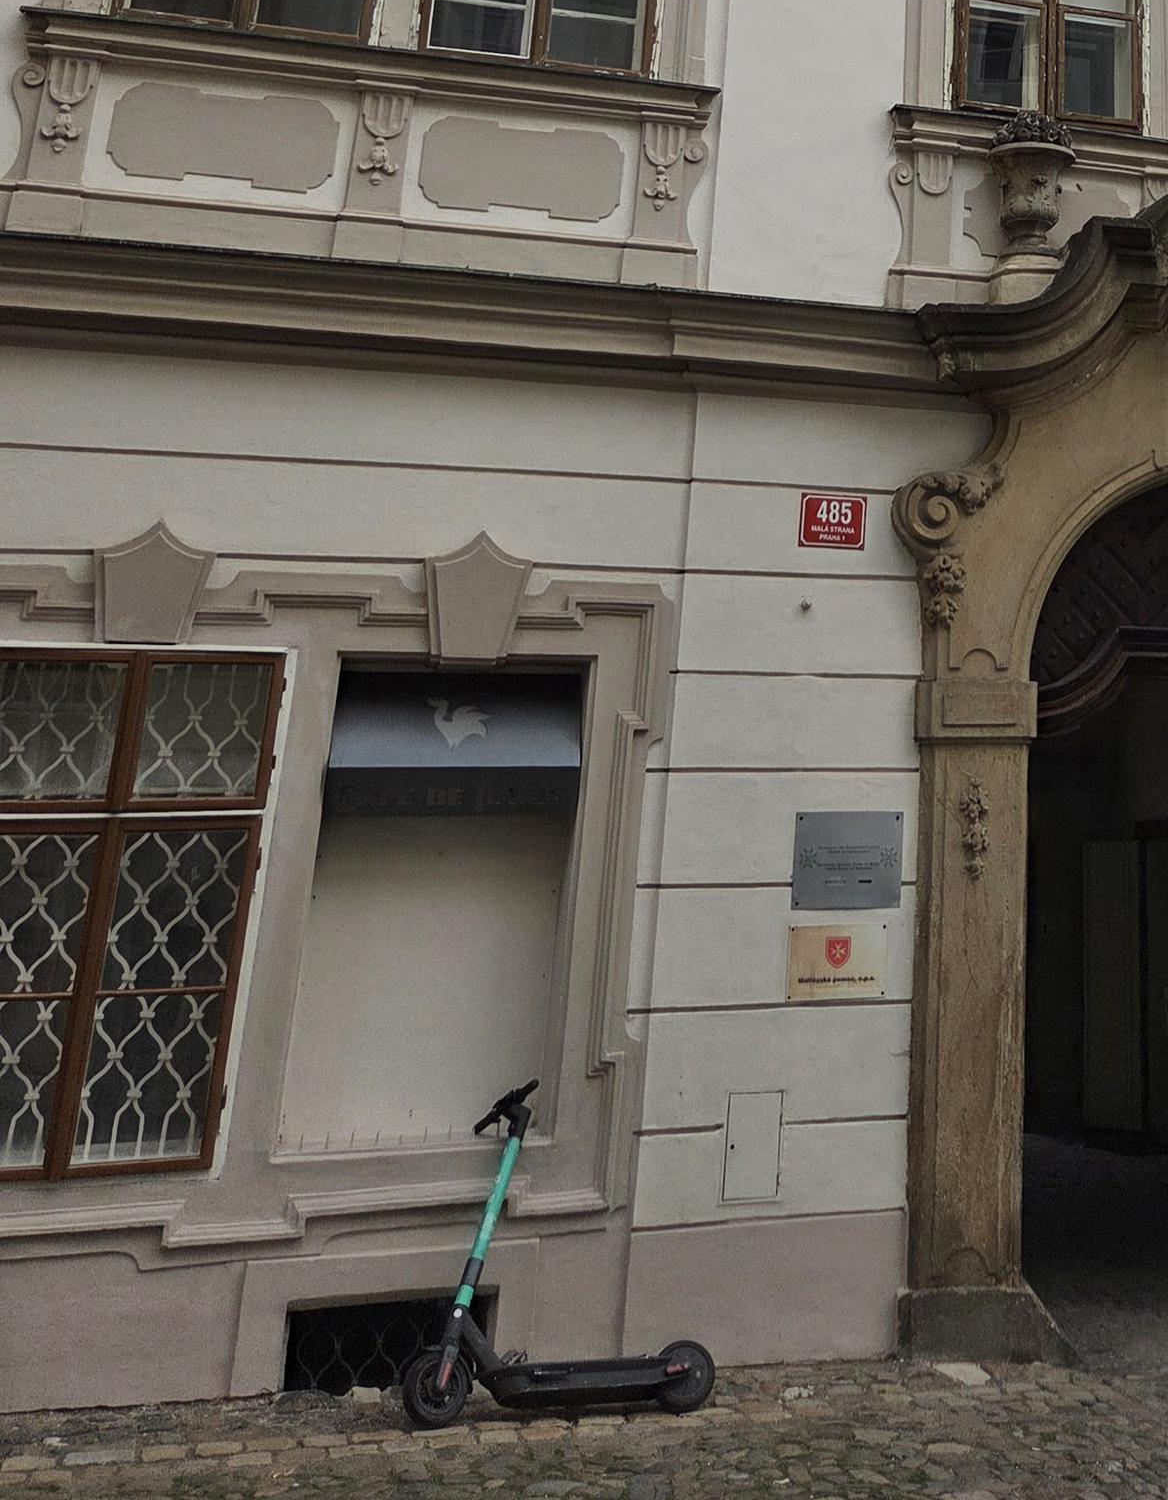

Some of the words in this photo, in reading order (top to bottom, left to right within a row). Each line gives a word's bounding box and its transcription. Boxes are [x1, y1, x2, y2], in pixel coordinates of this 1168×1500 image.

[816, 500, 852, 524] 485
[811, 524, 829, 532] MALÁ
[830, 526, 855, 534] STRANA
[819, 533, 841, 541] PRAHA
